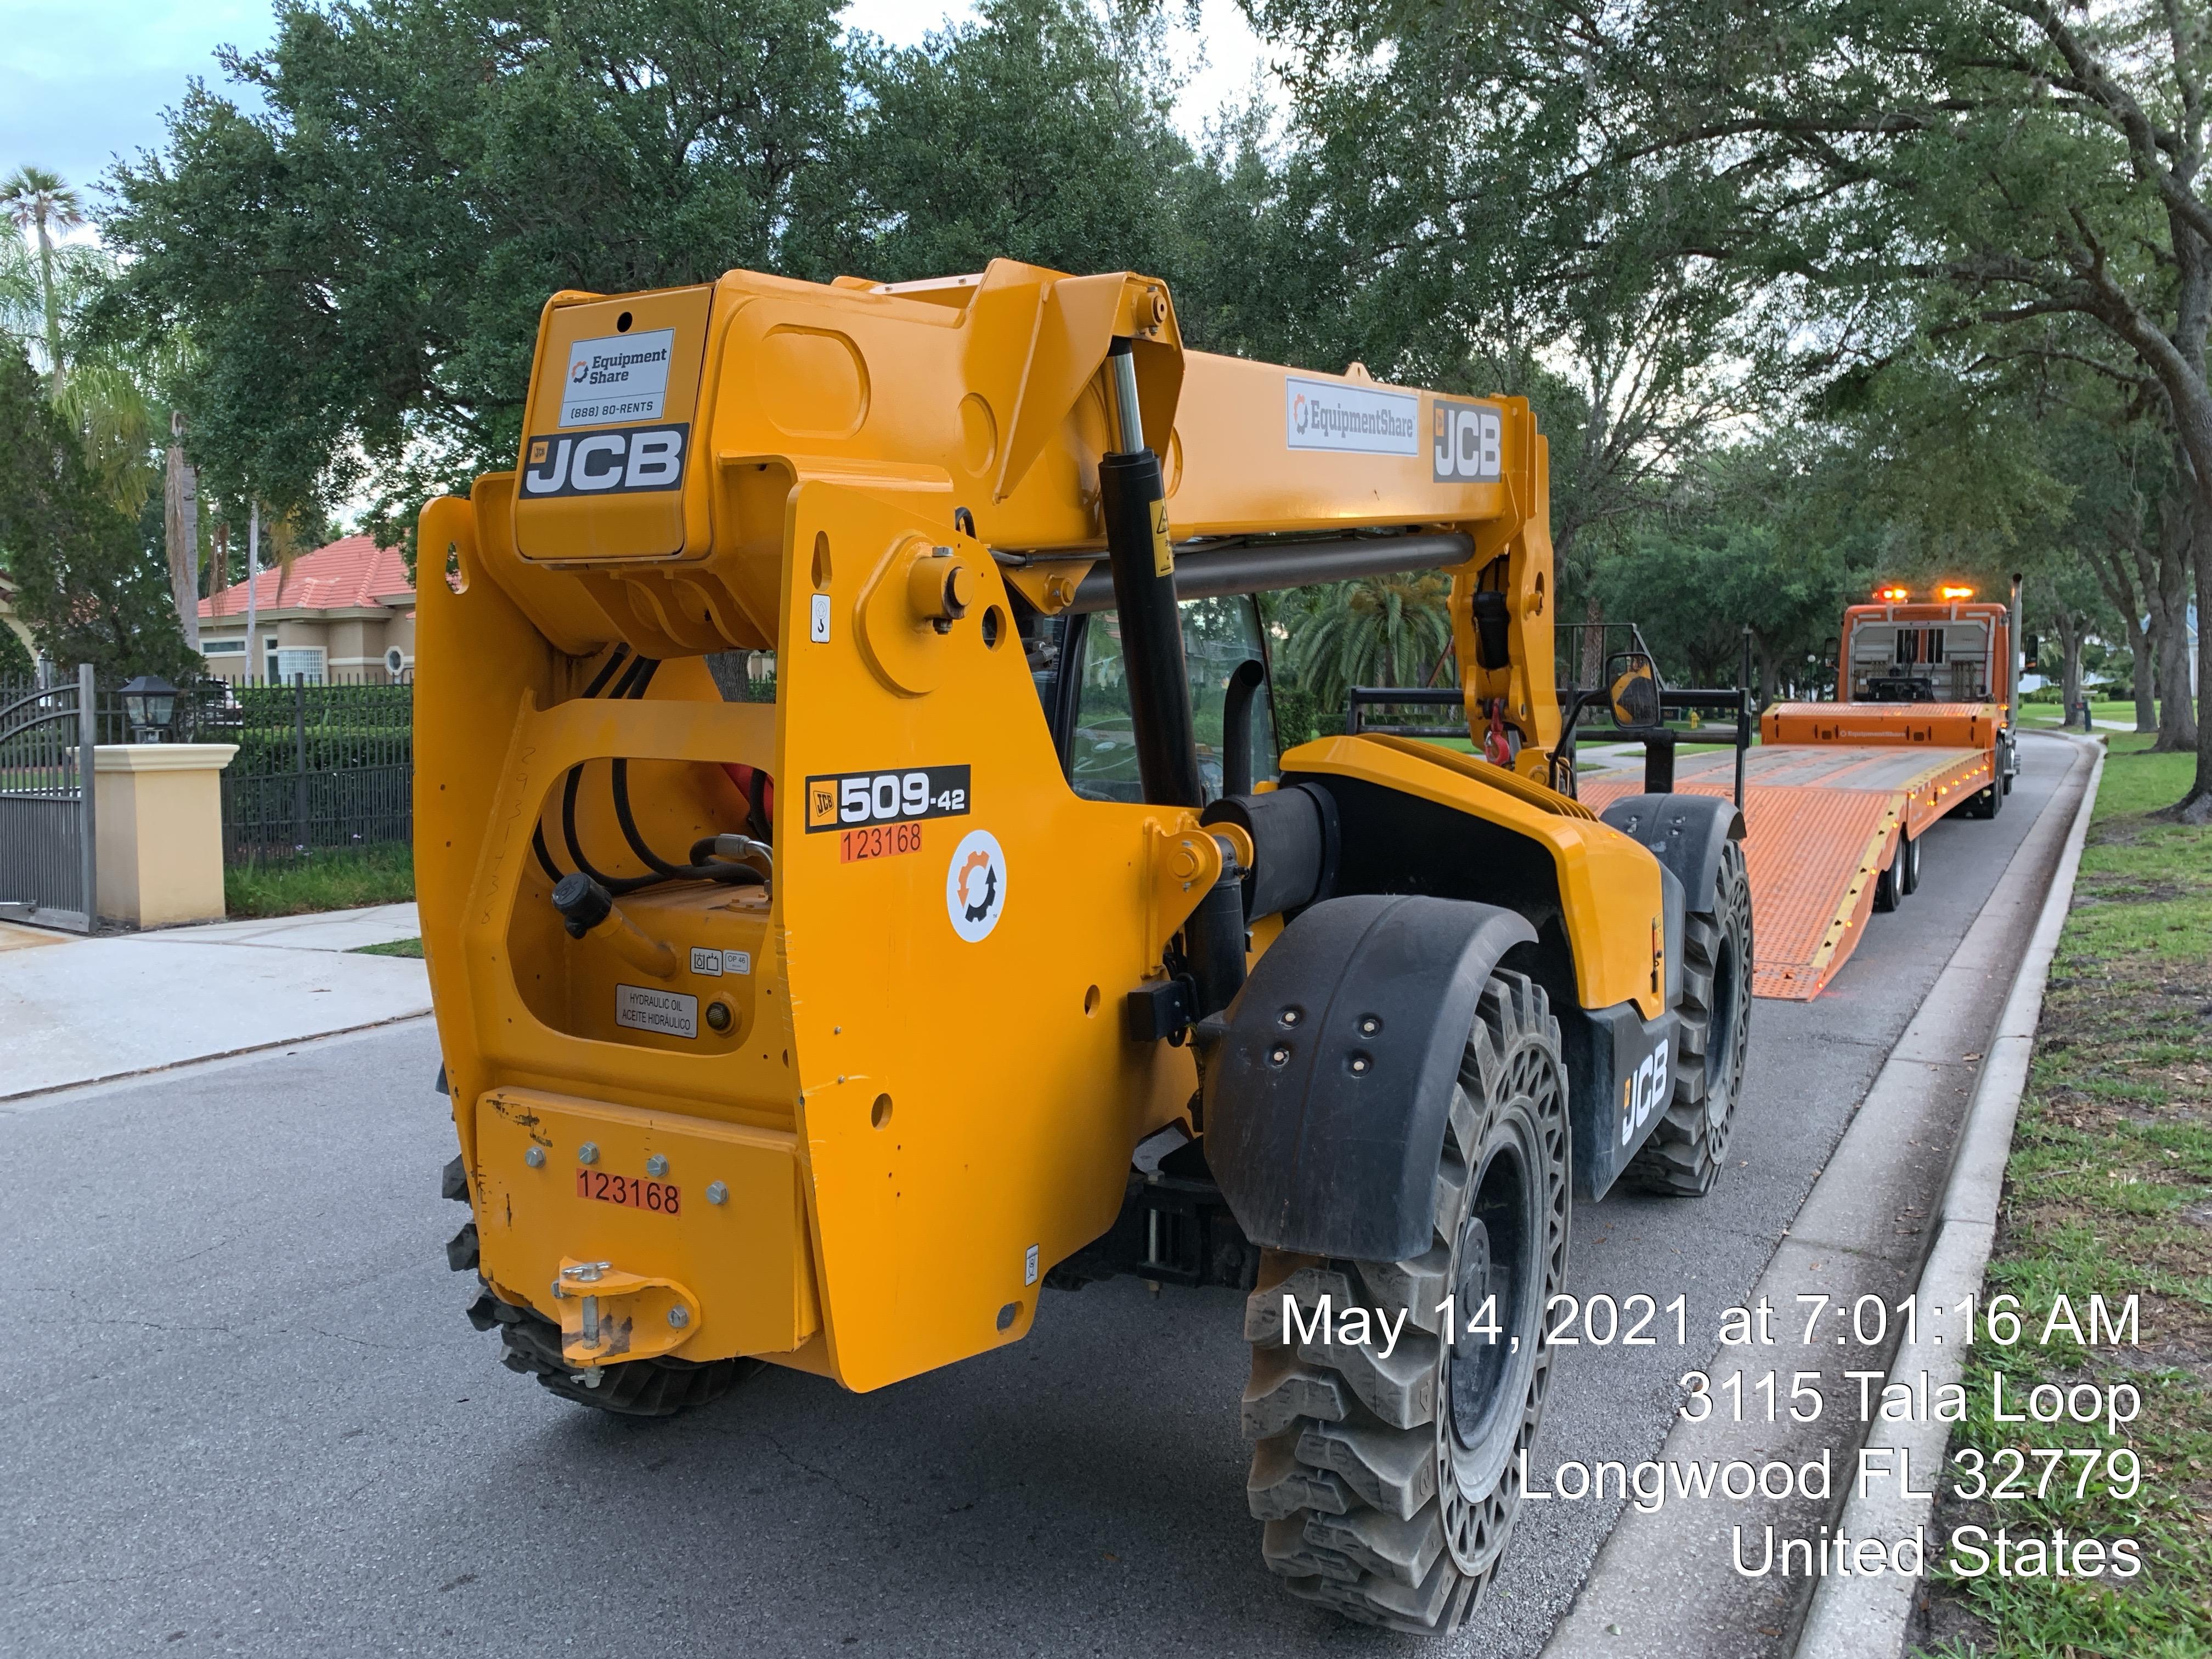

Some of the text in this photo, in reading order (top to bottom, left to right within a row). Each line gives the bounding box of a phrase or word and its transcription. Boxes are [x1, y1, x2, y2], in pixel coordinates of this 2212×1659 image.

[589, 371, 629, 385] Share
[591, 348, 667, 370] Equipment
[571, 401, 653, 419] (888) 80-RENTS
[1311, 400, 1414, 438] EquipmentShare
[526, 431, 682, 493] JCB
[1435, 409, 1501, 477] JCB
[816, 772, 965, 823] JCB 509-42
[843, 823, 921, 861] 123168
[622, 1009, 647, 1023] ACEITE
[630, 992, 683, 1012] HYDRAULIC OIL
[1622, 1039, 1669, 1146] JCB
[579, 1169, 680, 1214] 123168
